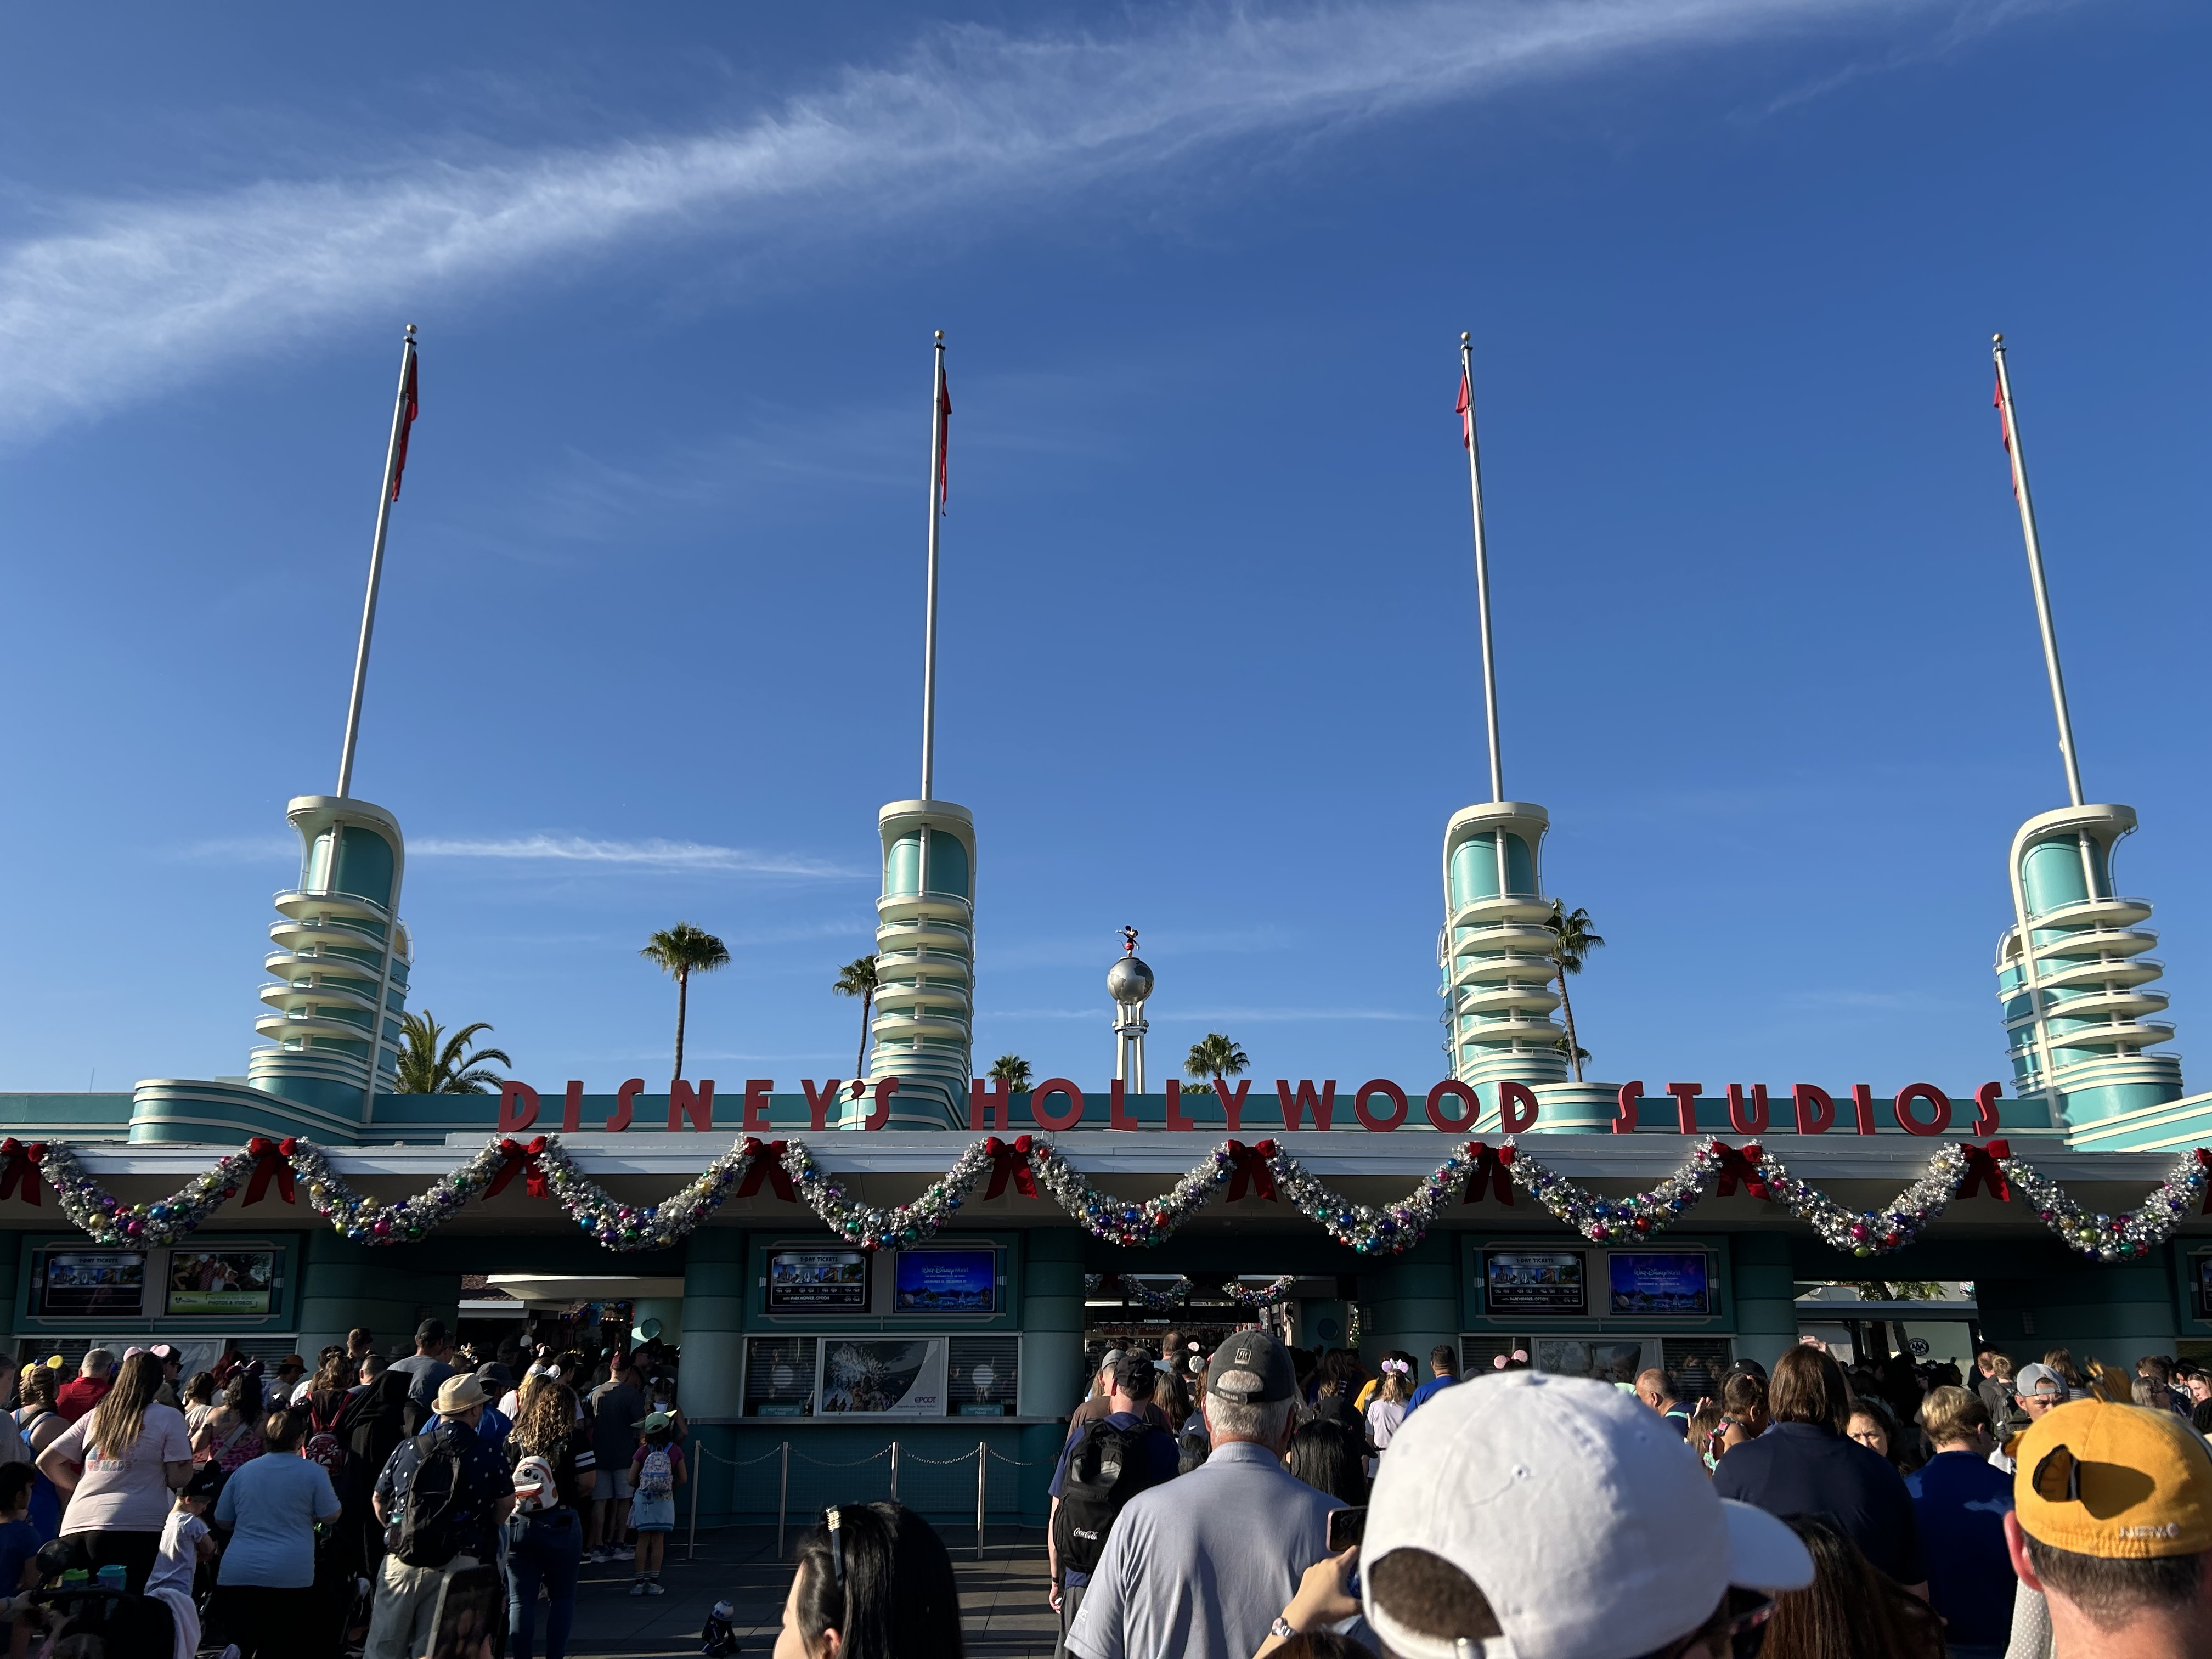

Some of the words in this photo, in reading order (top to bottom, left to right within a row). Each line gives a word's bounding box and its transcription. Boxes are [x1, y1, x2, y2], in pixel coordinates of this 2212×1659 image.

[498, 1077, 899, 1132] DISNEY'S
[970, 1077, 1539, 1133] HOLLYWOOD
[1612, 1080, 2002, 1136] STUDIOS
[1911, 1342, 1925, 1352] AAA
[1220, 1390, 1239, 1401] COLORADO
